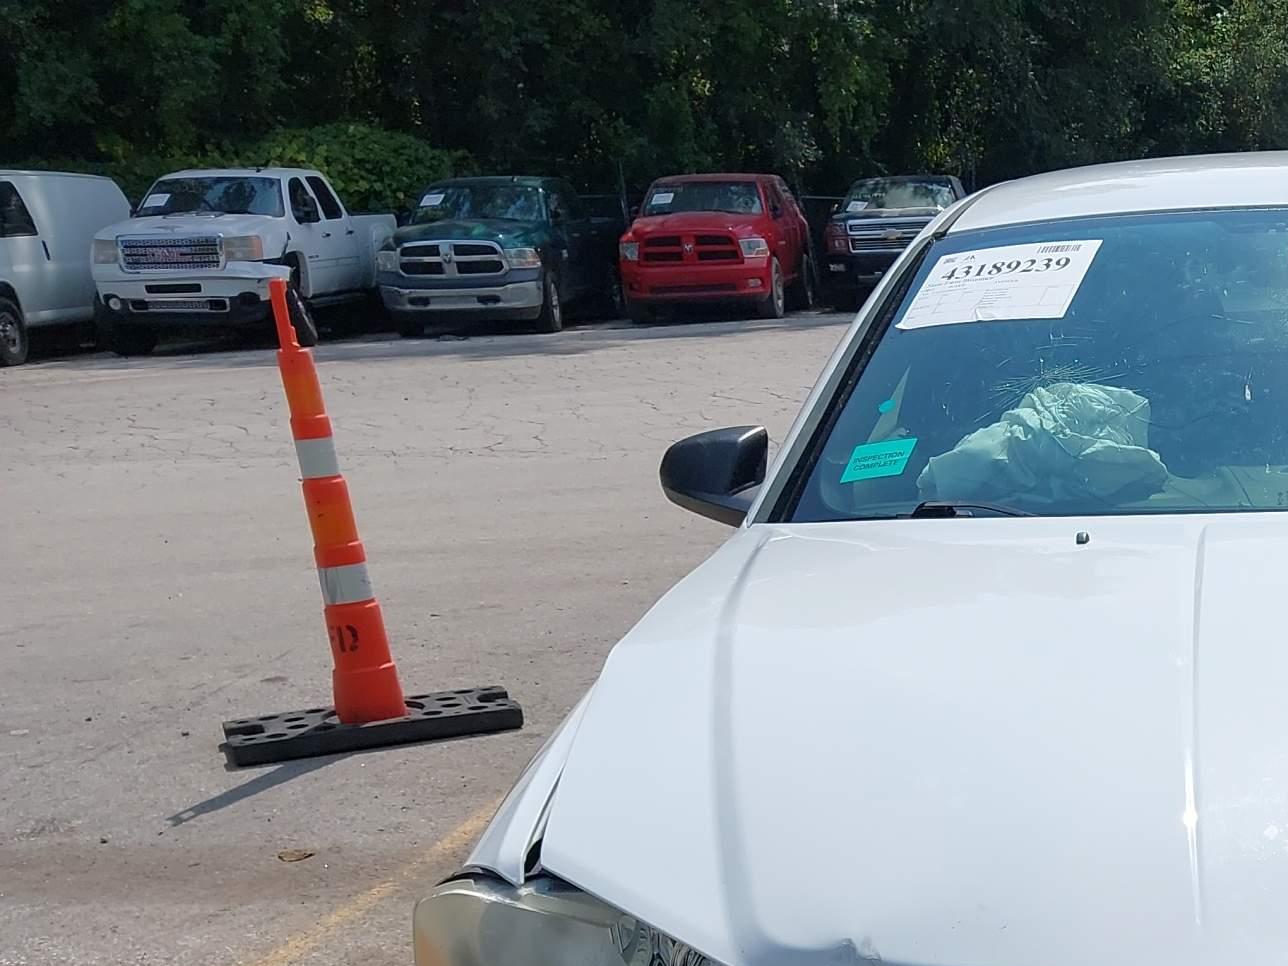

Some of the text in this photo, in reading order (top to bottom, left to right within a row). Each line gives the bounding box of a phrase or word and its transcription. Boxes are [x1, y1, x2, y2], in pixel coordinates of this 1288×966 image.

[941, 257, 1071, 281] 43189239
[853, 452, 904, 464] INSPECTION
[853, 459, 898, 472] COMPLETE
